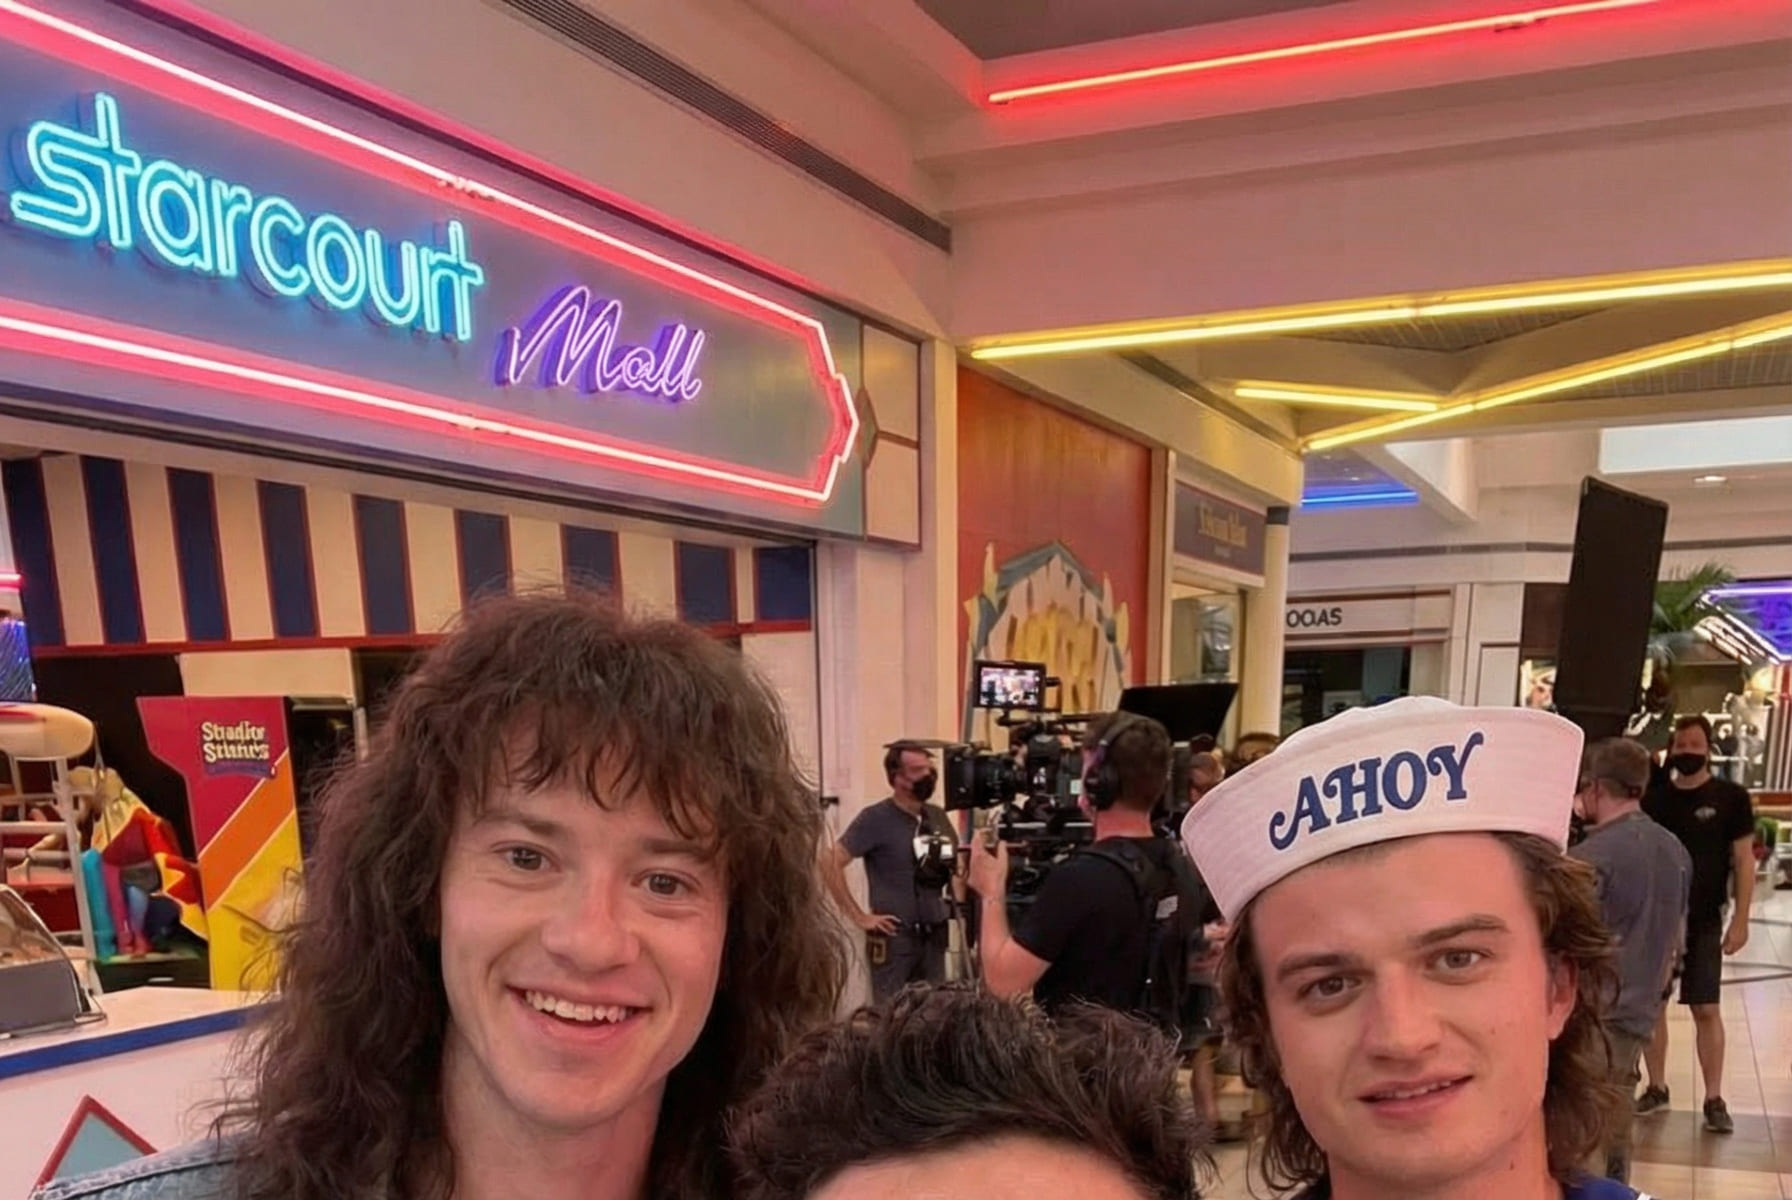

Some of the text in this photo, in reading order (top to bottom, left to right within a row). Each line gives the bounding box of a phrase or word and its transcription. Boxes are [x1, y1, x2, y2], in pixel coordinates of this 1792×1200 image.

[11, 92, 705, 400] starcourt Mall
[1269, 731, 1484, 850] AHOY
